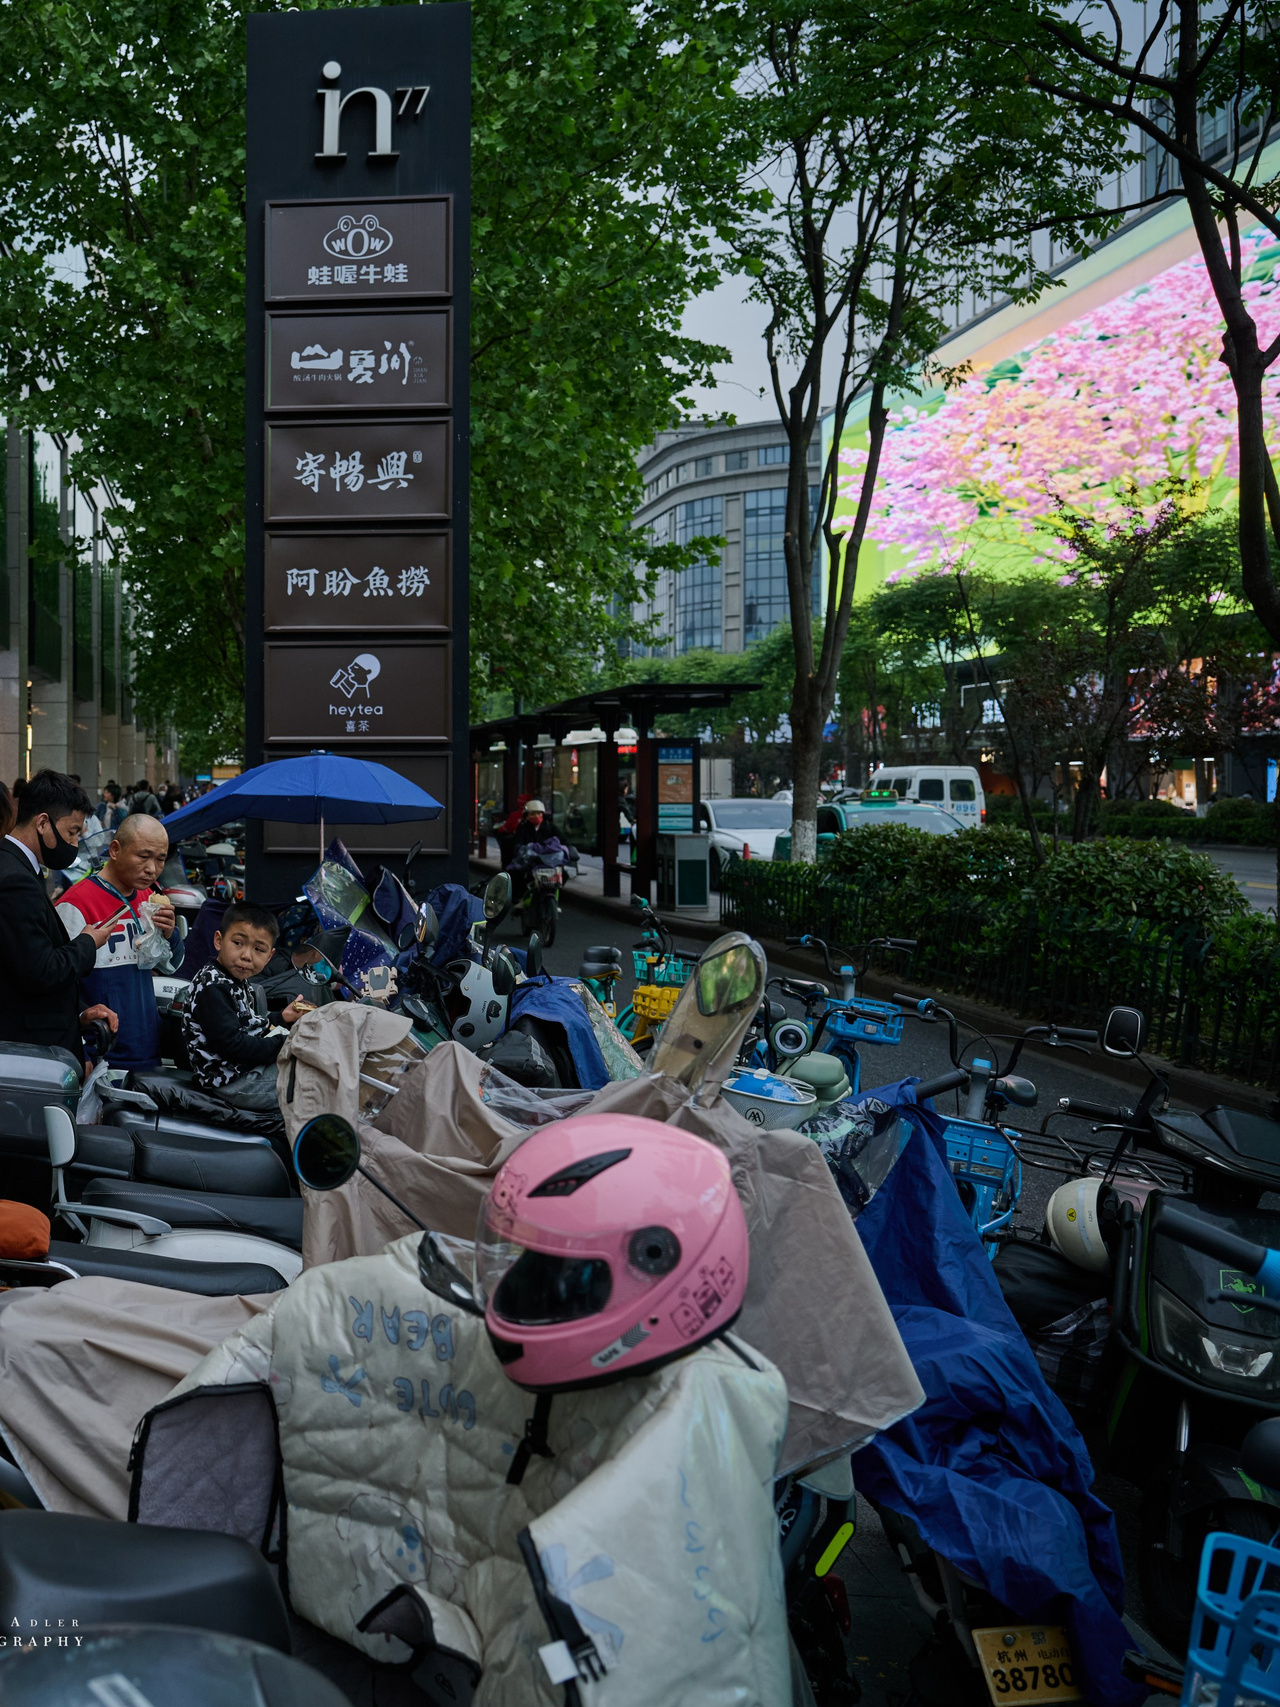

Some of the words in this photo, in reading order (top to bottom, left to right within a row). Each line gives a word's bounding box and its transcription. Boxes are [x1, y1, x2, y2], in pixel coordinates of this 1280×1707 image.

[331, 228, 384, 257] WOW
[307, 263, 409, 285] 蛙喔牛蛙
[286, 565, 431, 598] 阿盼魚撈
[329, 704, 384, 717] heytea
[345, 720, 370, 733] 喜茶
[997, 1649, 1029, 1664] 杭州
